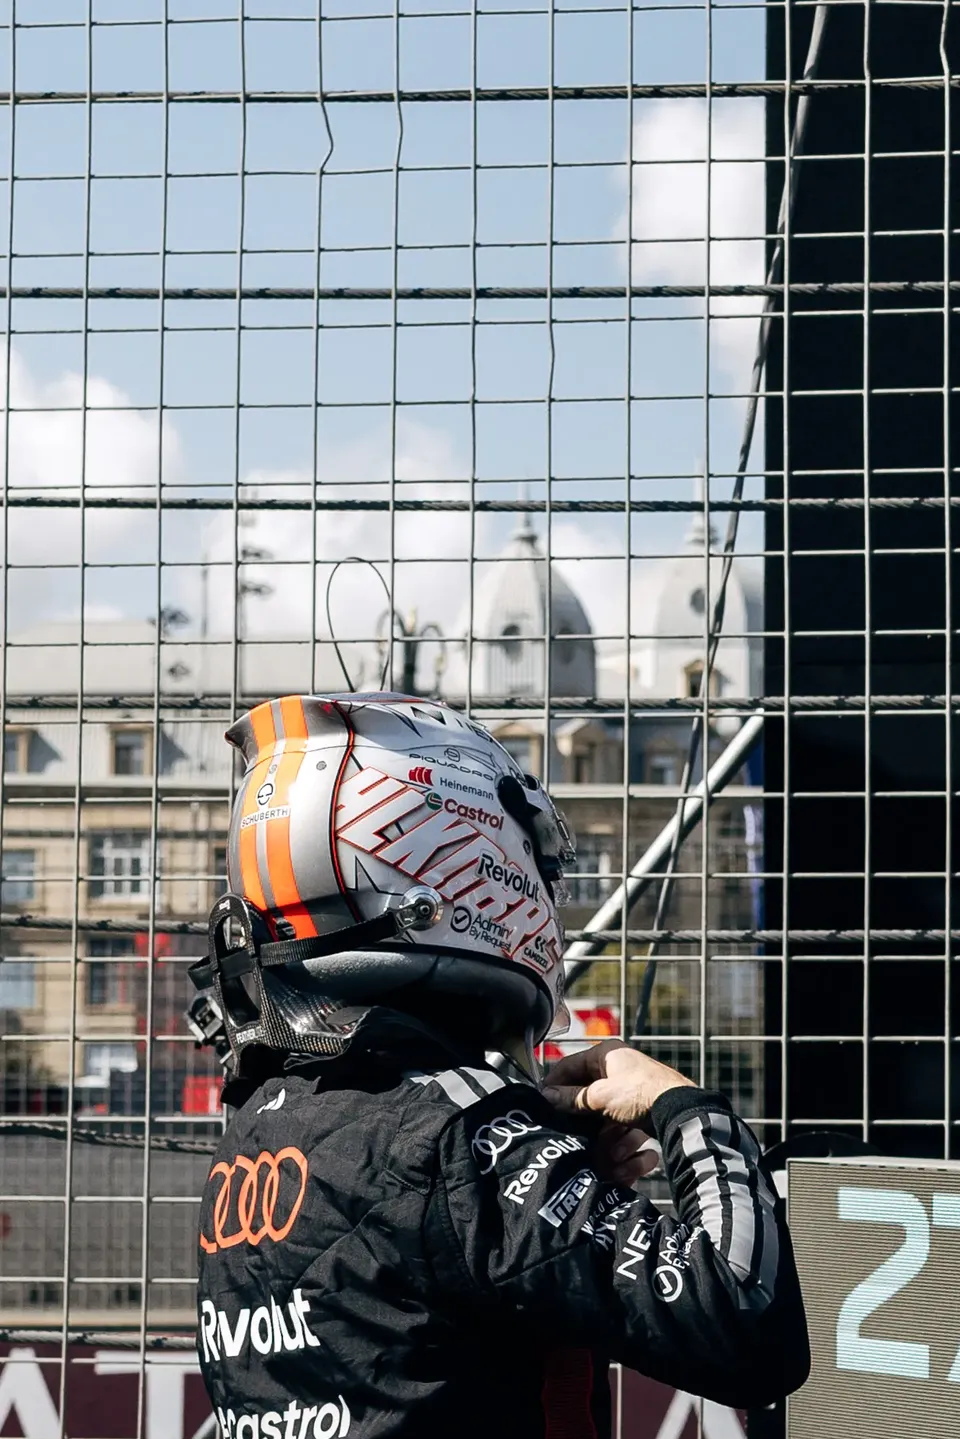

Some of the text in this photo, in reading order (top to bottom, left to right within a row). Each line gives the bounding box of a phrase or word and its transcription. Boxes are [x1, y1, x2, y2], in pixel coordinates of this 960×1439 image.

[409, 753, 494, 781] PIQUADRO
[439, 777, 494, 801] Heinemann
[242, 808, 288, 828] SCHUBERTH
[444, 798, 505, 831] Castrol
[477, 853, 540, 903] Revolut
[468, 926, 512, 953] By Request
[472, 913, 510, 940] Admin
[201, 1288, 321, 1363] Rvolut
